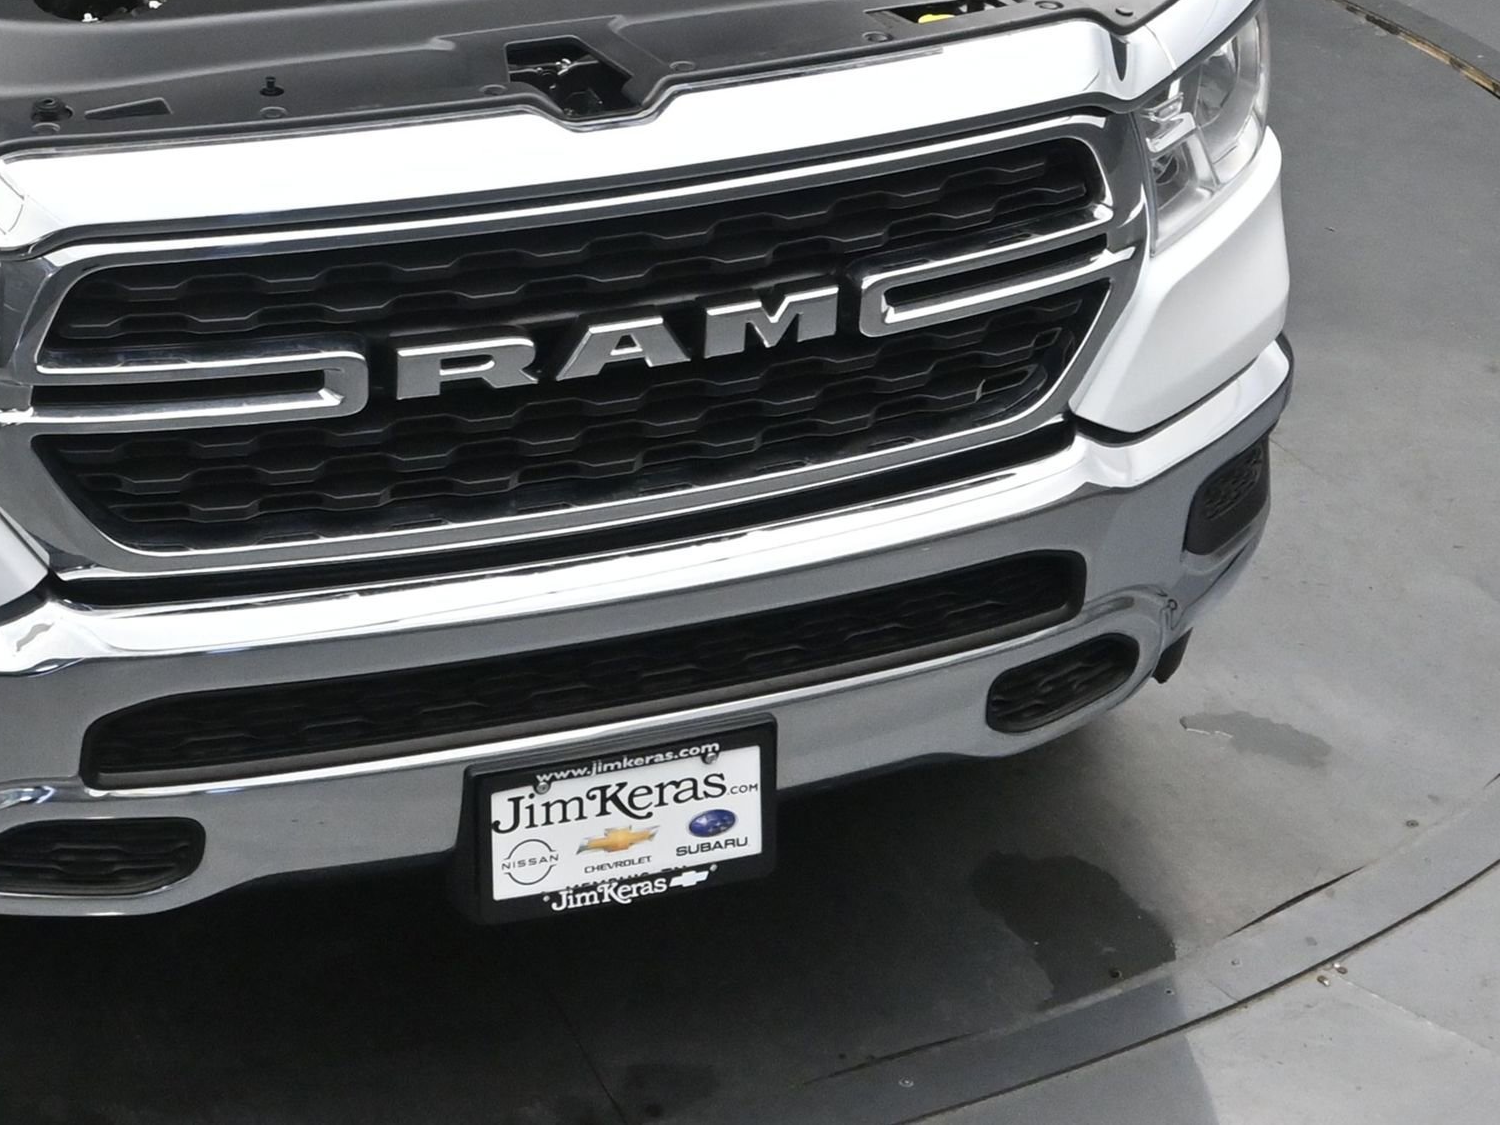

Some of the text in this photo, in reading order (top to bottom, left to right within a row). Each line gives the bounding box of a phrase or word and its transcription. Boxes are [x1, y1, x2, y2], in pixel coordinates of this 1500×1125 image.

[396, 285, 840, 401] RAM
[535, 741, 721, 783] www.jimkeras.com
[675, 836, 749, 857] SUBARU
[501, 853, 560, 871] NISSAN
[583, 854, 653, 874] CHEVROLET
